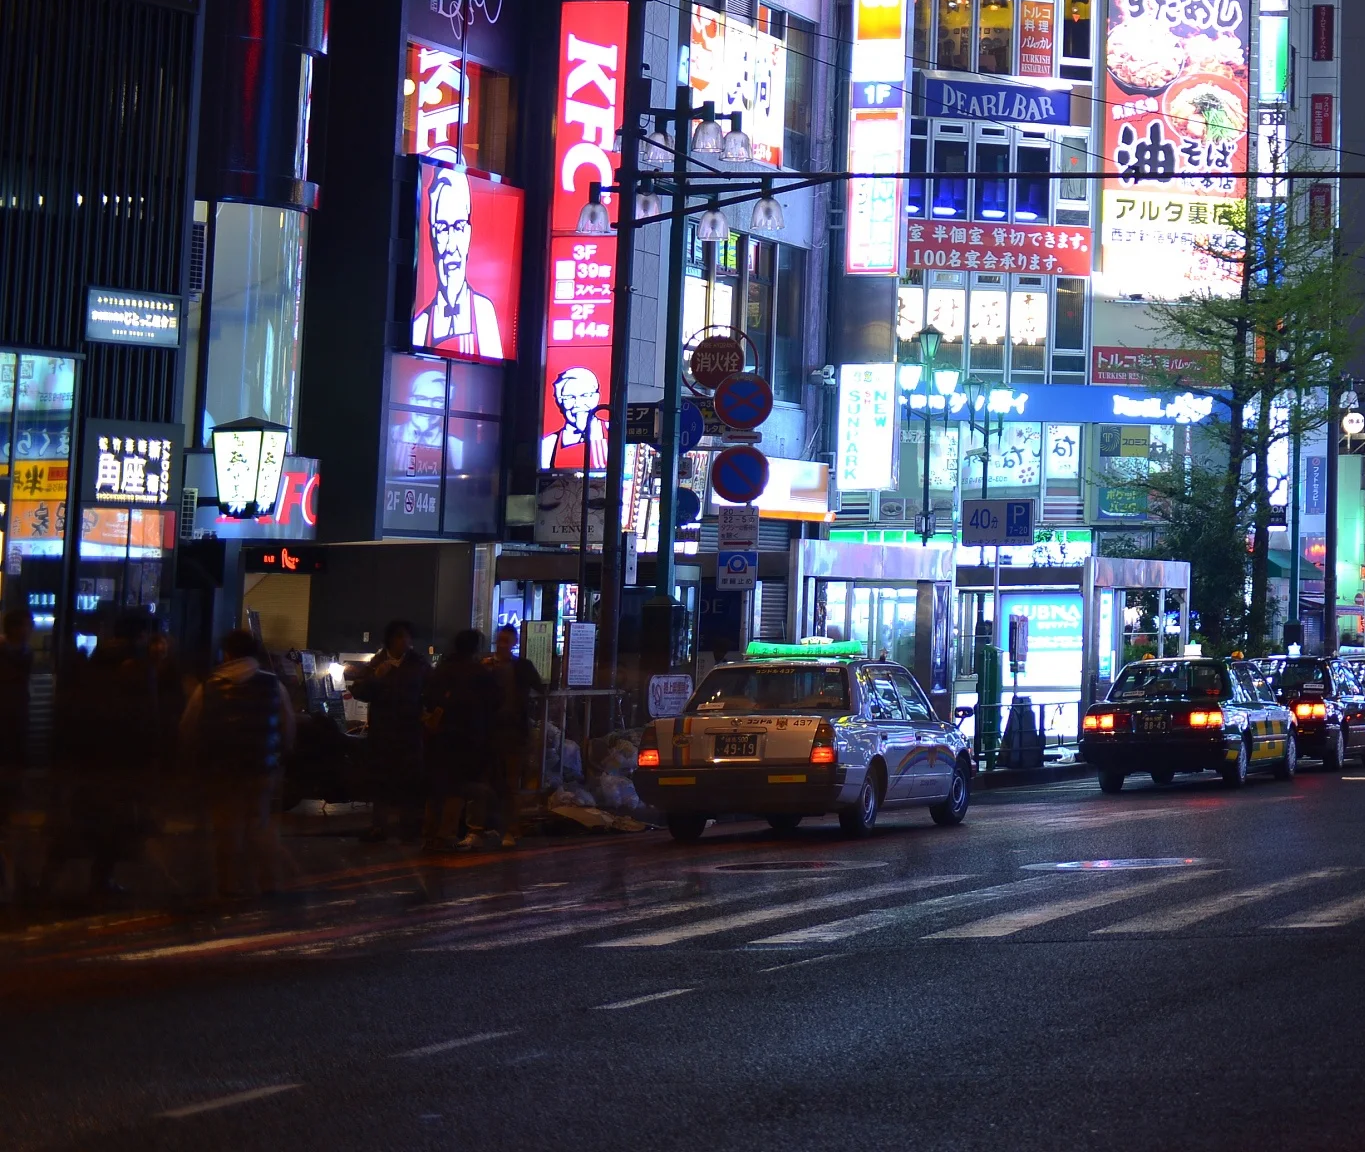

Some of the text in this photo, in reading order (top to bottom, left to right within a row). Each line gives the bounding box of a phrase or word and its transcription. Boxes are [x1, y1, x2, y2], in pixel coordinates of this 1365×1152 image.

[1021, 4, 1052, 20] トルコ
[1022, 19, 1050, 33] 料理
[1021, 35, 1053, 50] パムッカレ
[1021, 54, 1051, 64] TURKISH
[1021, 63, 1051, 75] RESTAURANT
[864, 84, 892, 105] 1F
[940, 82, 1057, 120] PEARL BAR
[563, 33, 618, 193] KFC
[1114, 122, 1175, 186] 油
[1179, 140, 1236, 169] そば
[933, 224, 983, 246] 半個室
[993, 227, 1089, 253] 貸切できます。
[573, 244, 598, 261] 3F
[911, 249, 1064, 275] 100名宴会承ります。
[570, 304, 595, 320] 2F
[695, 351, 741, 373] 消火栓
[1097, 370, 1125, 381] TURKISH
[875, 389, 889, 428] NEW
[96, 452, 147, 494] 角座
[386, 491, 401, 511] 2F
[1105, 489, 1138, 501] ポケット
[723, 508, 756, 516] 20 7
[1107, 501, 1138, 513] バンク
[968, 506, 1000, 531] 40分
[1011, 505, 1027, 526] P
[1008, 525, 1029, 537] 7-20
[746, 718, 813, 727] コンドル 437
[1144, 721, 1167, 731] 88-43
[722, 743, 755, 756] 49-19
